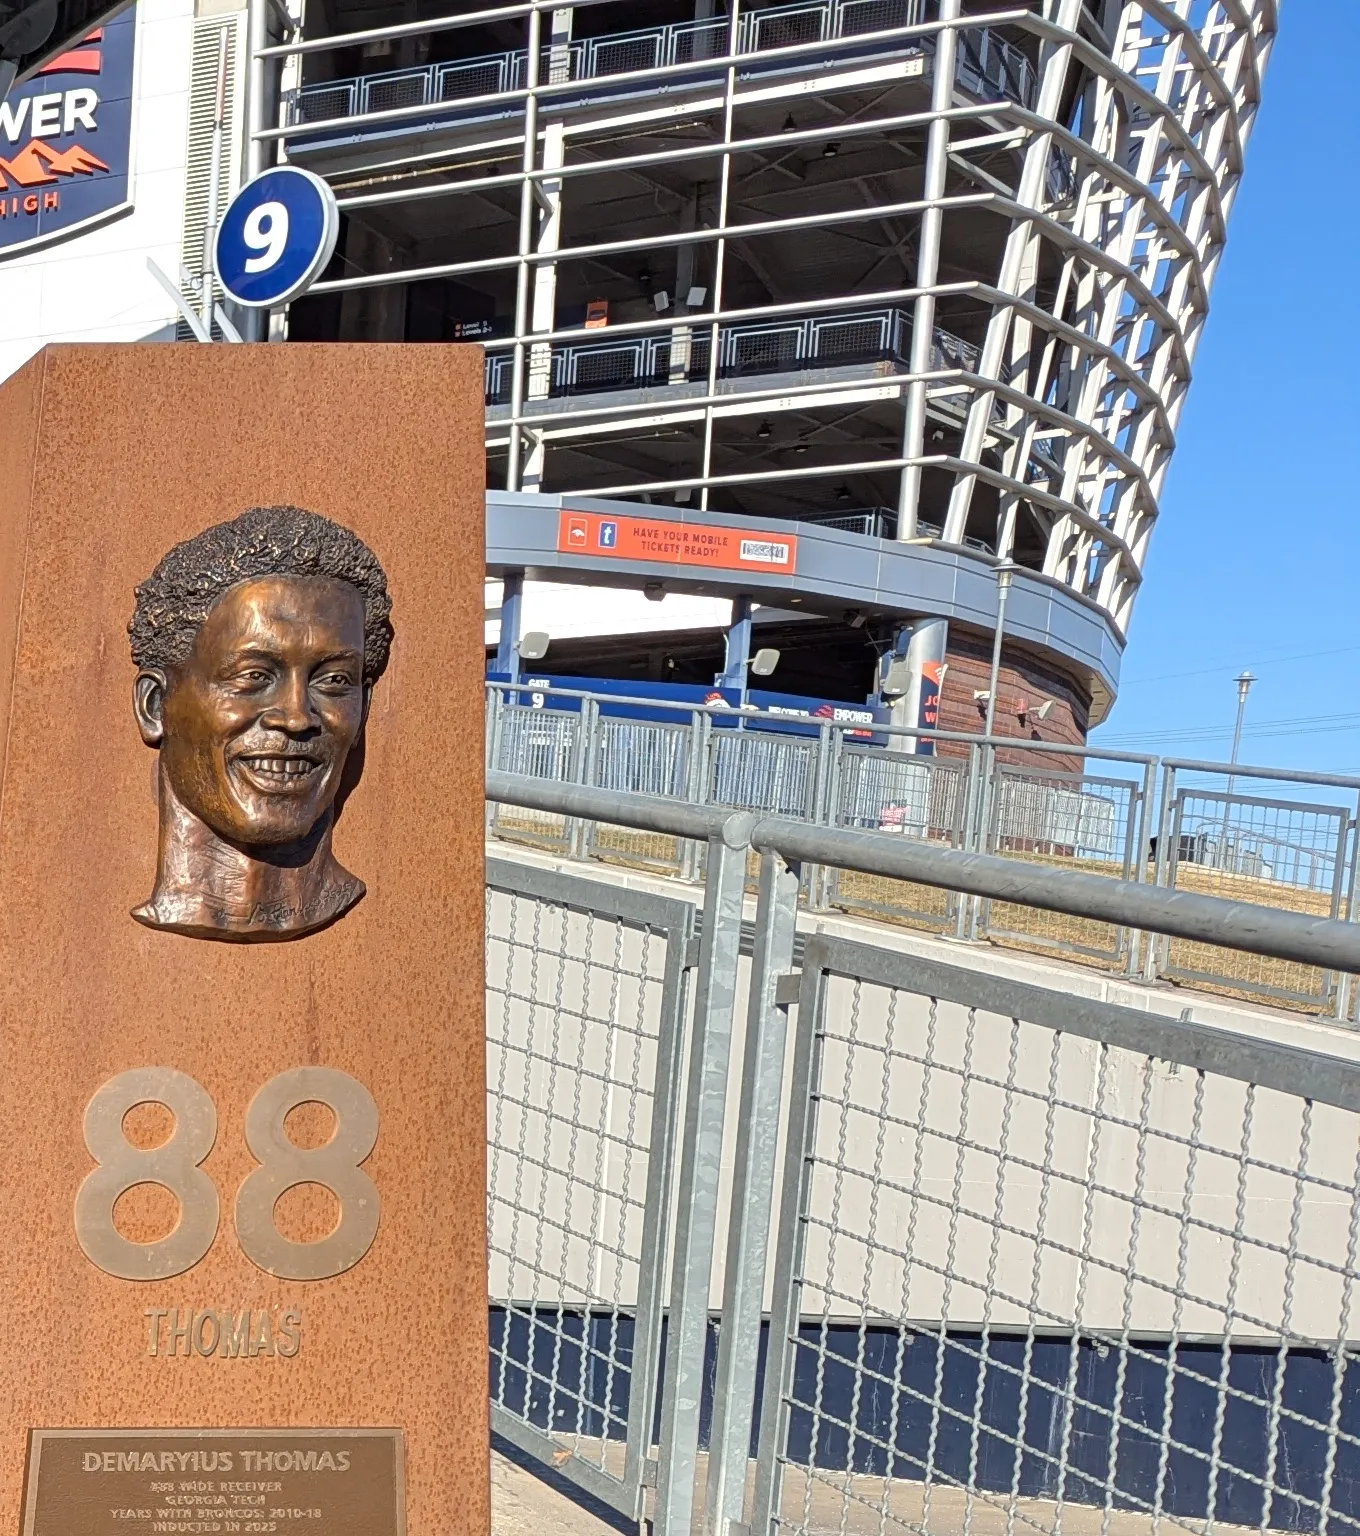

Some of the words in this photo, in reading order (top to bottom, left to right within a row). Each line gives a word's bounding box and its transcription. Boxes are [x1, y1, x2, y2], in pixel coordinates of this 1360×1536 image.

[243, 201, 289, 274] 9
[633, 527, 659, 539] HAVE
[663, 529, 689, 542] YOUR
[693, 533, 729, 546] MOBILE
[641, 540, 680, 554] TICKETS
[685, 545, 719, 557] READY!
[528, 678, 550, 688] GATE
[532, 693, 544, 709] 9
[833, 708, 873, 724] EMPOWER
[74, 1065, 381, 1281] 88
[144, 1307, 302, 1358] THOMAS
[82, 1451, 234, 1473] DEMARYIUS
[240, 1450, 352, 1472] THOMAS
[180, 1481, 215, 1492] WIDE
[220, 1481, 283, 1492] RECEIVER
[165, 1495, 228, 1506] GEORGIA
[232, 1495, 267, 1505] TECH
[110, 1508, 152, 1519] YEARS
[156, 1508, 192, 1519] WITH
[197, 1508, 265, 1519] BRONCOS:
[268, 1508, 322, 1518] 2010-18
[153, 1521, 221, 1532] INDUCTED
[225, 1521, 240, 1532] IN
[244, 1521, 277, 1532] 2025
